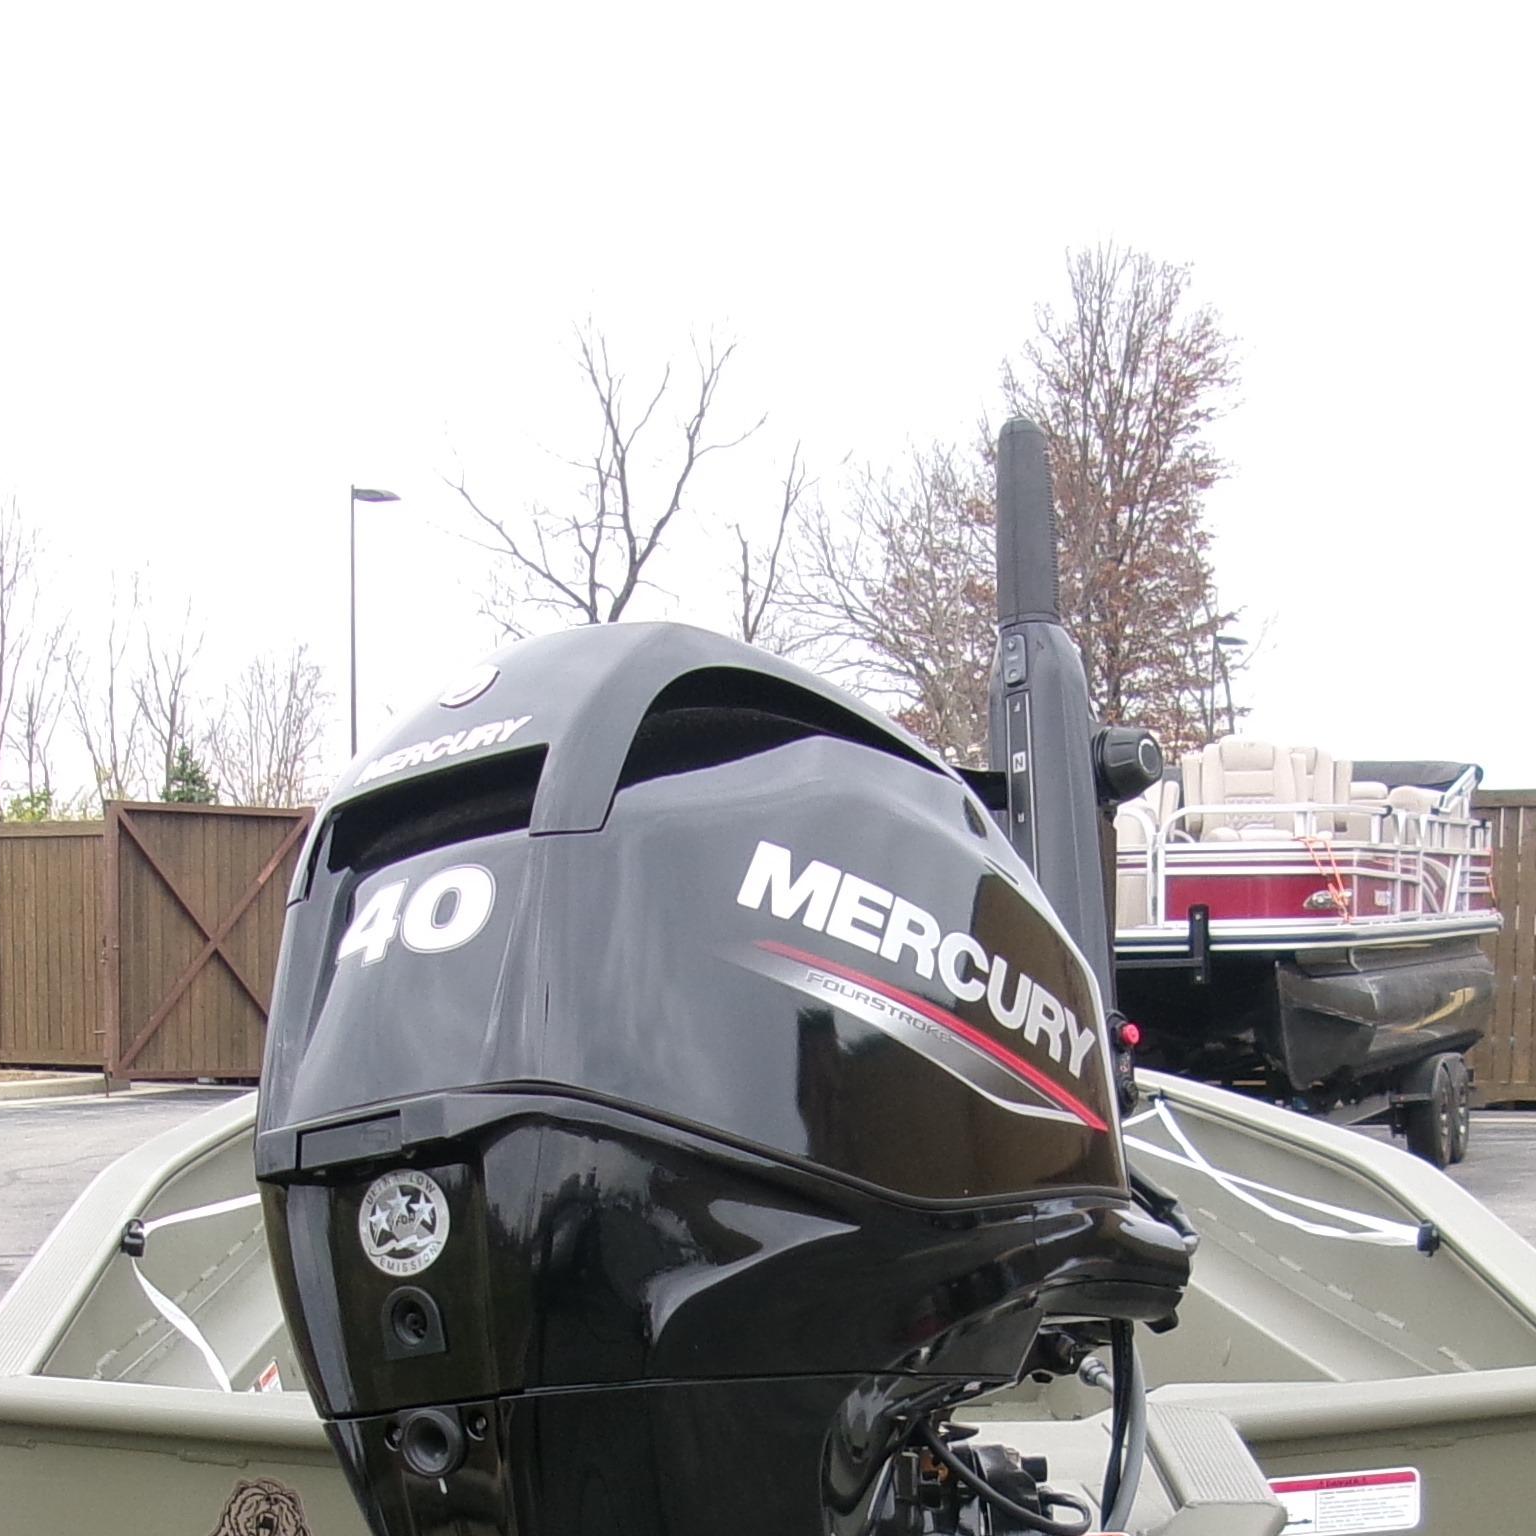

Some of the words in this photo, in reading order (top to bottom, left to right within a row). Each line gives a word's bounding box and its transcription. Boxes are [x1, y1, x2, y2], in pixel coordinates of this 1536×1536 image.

[353, 715, 533, 787] MERCURY
[335, 863, 496, 967] 40
[737, 840, 1095, 1079] MERCURY
[806, 970, 952, 1044] FOURSTROKE
[410, 1173, 435, 1194] LOW
[379, 1243, 438, 1273] EMISSION
